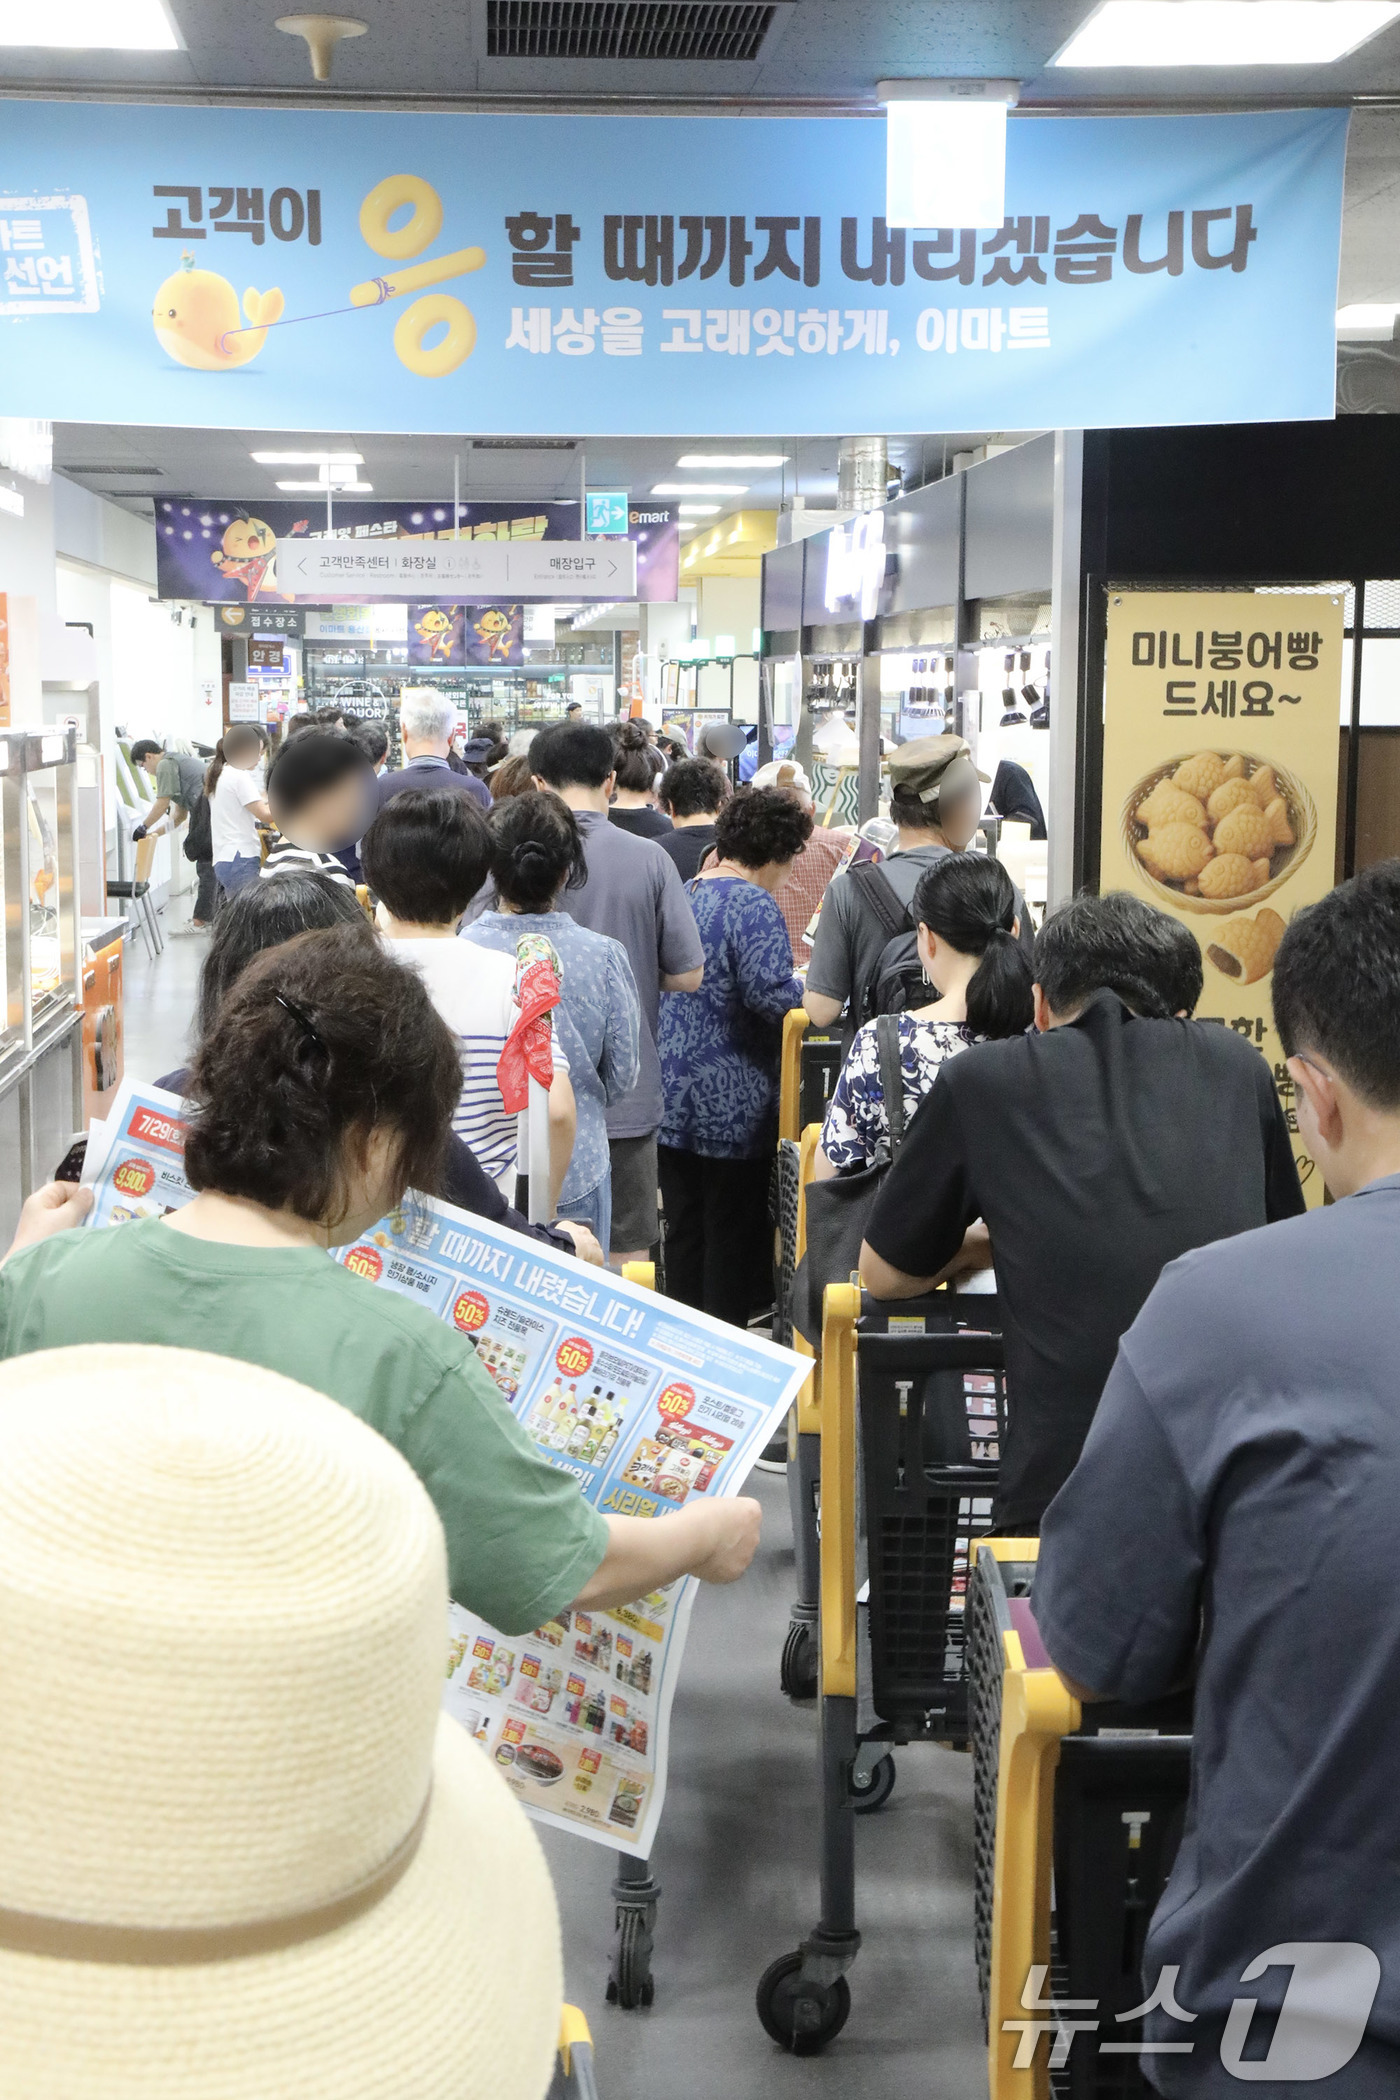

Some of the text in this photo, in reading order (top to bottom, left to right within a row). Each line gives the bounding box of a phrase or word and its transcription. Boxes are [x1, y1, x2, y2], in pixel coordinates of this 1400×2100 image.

[152, 185, 321, 246] 고객이
[504, 211, 580, 288] 할
[603, 215, 820, 287] 때까지
[840, 204, 1257, 287] 내리겠습니다
[505, 307, 1051, 357] 세상을 고래잇하게, 이마트
[629, 510, 670, 524] emart
[355, 520, 398, 538] 페스타
[319, 556, 436, 570] 고객만족센터 화장실
[550, 558, 596, 571] 매장입구
[251, 615, 298, 628] 접수장소
[320, 624, 345, 634] 이마트
[252, 649, 281, 663] 안경
[1132, 630, 1323, 670] 미니붕어빵
[340, 697, 379, 706] WINE &
[1163, 680, 1302, 718] 드세요~
[161, 1170, 184, 1187] 비스킷
[438, 1230, 514, 1282] 때까지
[514, 1261, 646, 1339] 내렸습니다!
[455, 1299, 485, 1323] 50%
[558, 1345, 588, 1370] 50%
[659, 1391, 690, 1416] 50%
